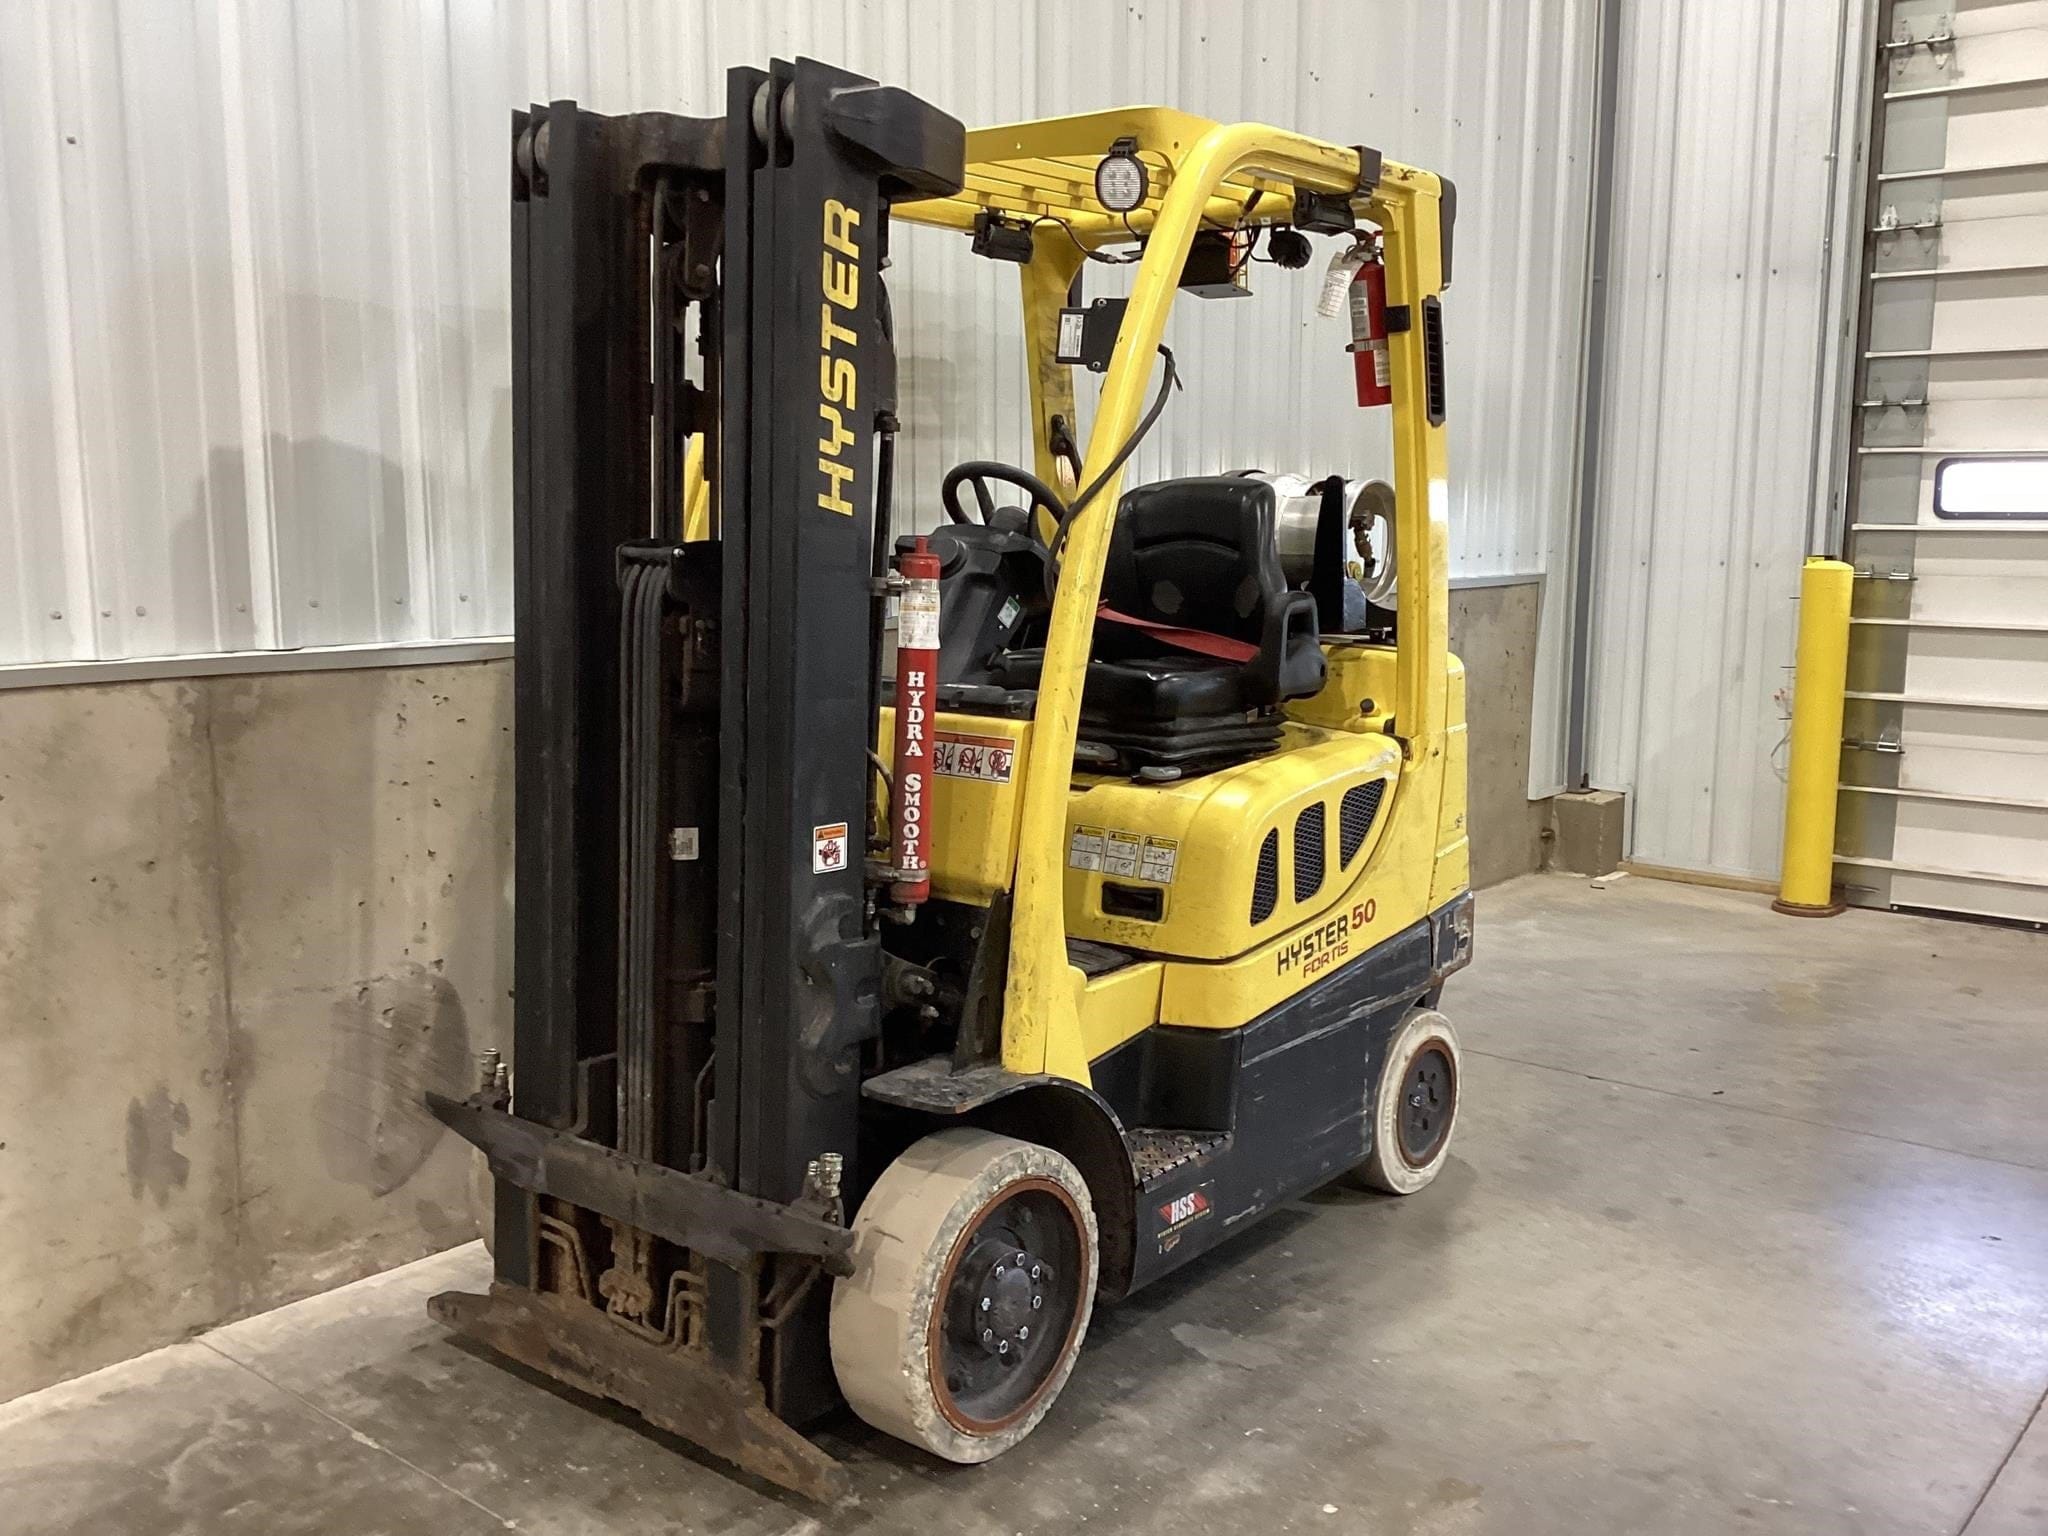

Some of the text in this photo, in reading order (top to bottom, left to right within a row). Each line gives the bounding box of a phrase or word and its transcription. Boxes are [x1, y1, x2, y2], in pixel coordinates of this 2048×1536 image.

[818, 198, 861, 517] HYSTER
[904, 671, 926, 757] HYDRA
[1277, 898, 1377, 977] HYSTER 50
[1303, 940, 1349, 978] FORTIS
[1170, 1192, 1196, 1225] HSS
